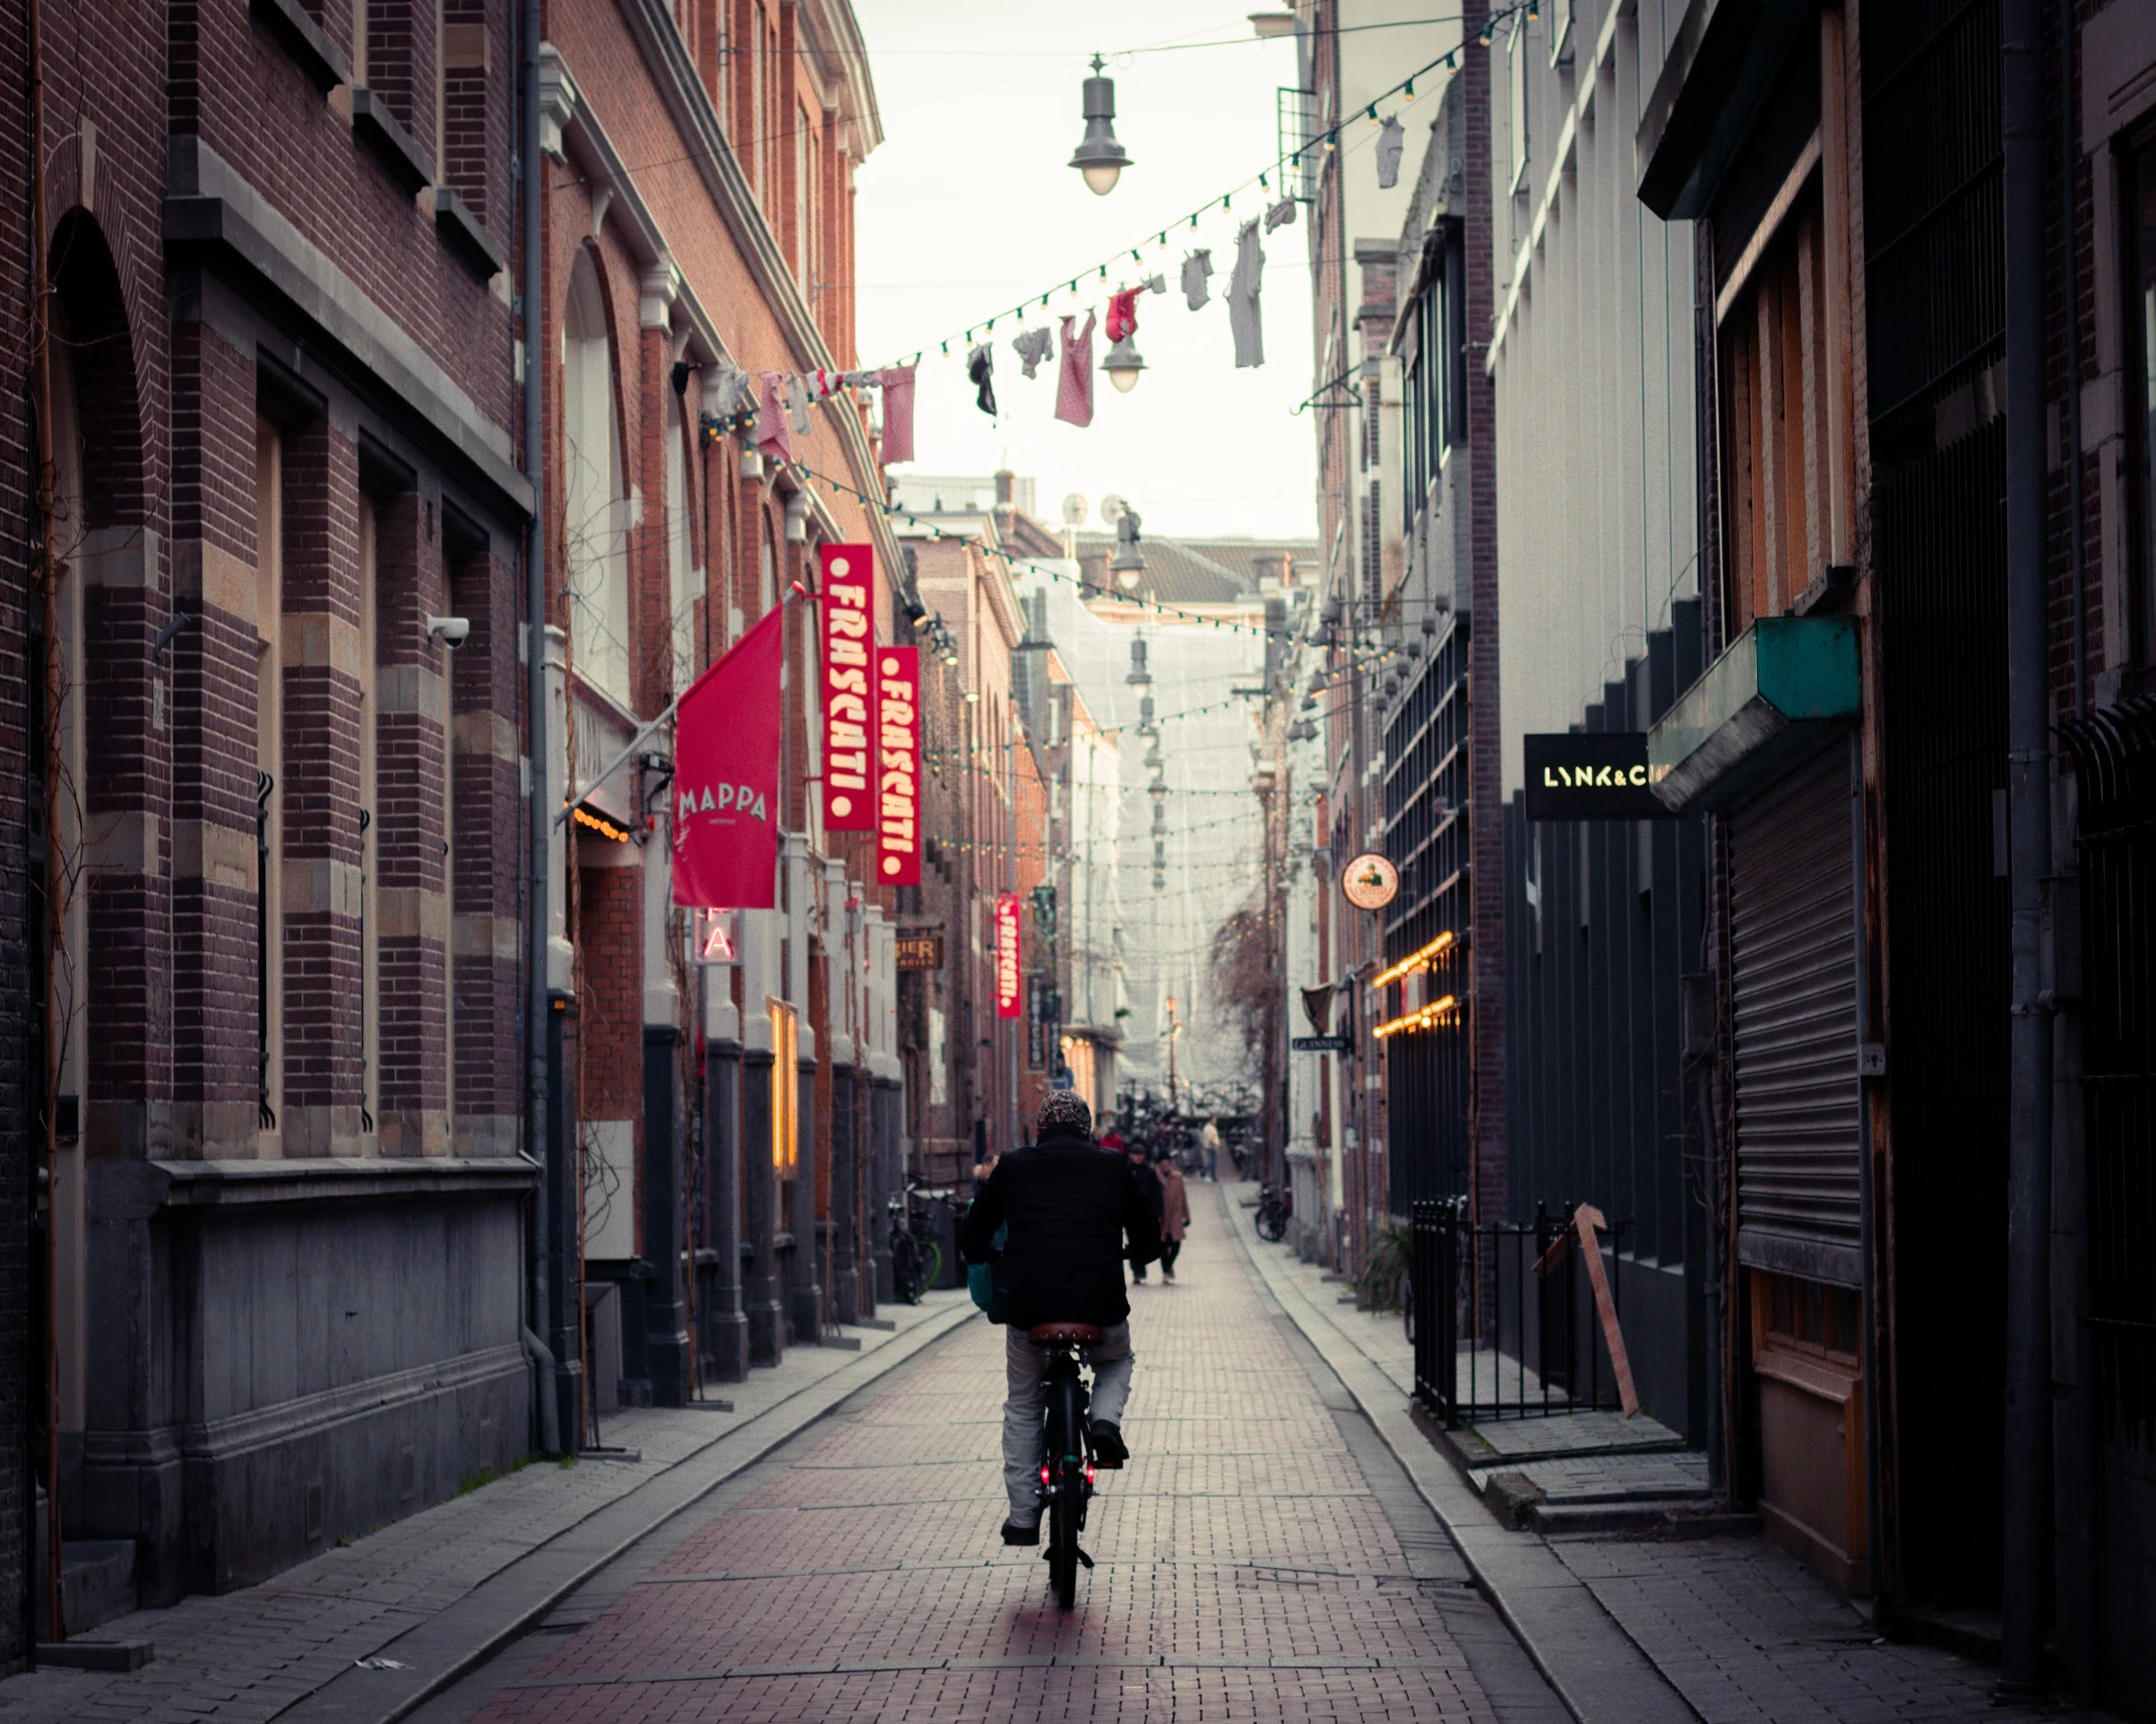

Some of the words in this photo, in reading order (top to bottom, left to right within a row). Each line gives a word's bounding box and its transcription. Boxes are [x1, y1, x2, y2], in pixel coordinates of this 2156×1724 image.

[830, 583, 867, 789] FRASCATI
[678, 782, 767, 822] MAPPA
[882, 681, 914, 853] FRASCATI
[1544, 765, 1647, 787] LYNK&C
[1000, 915, 1018, 997] FRASCATI
